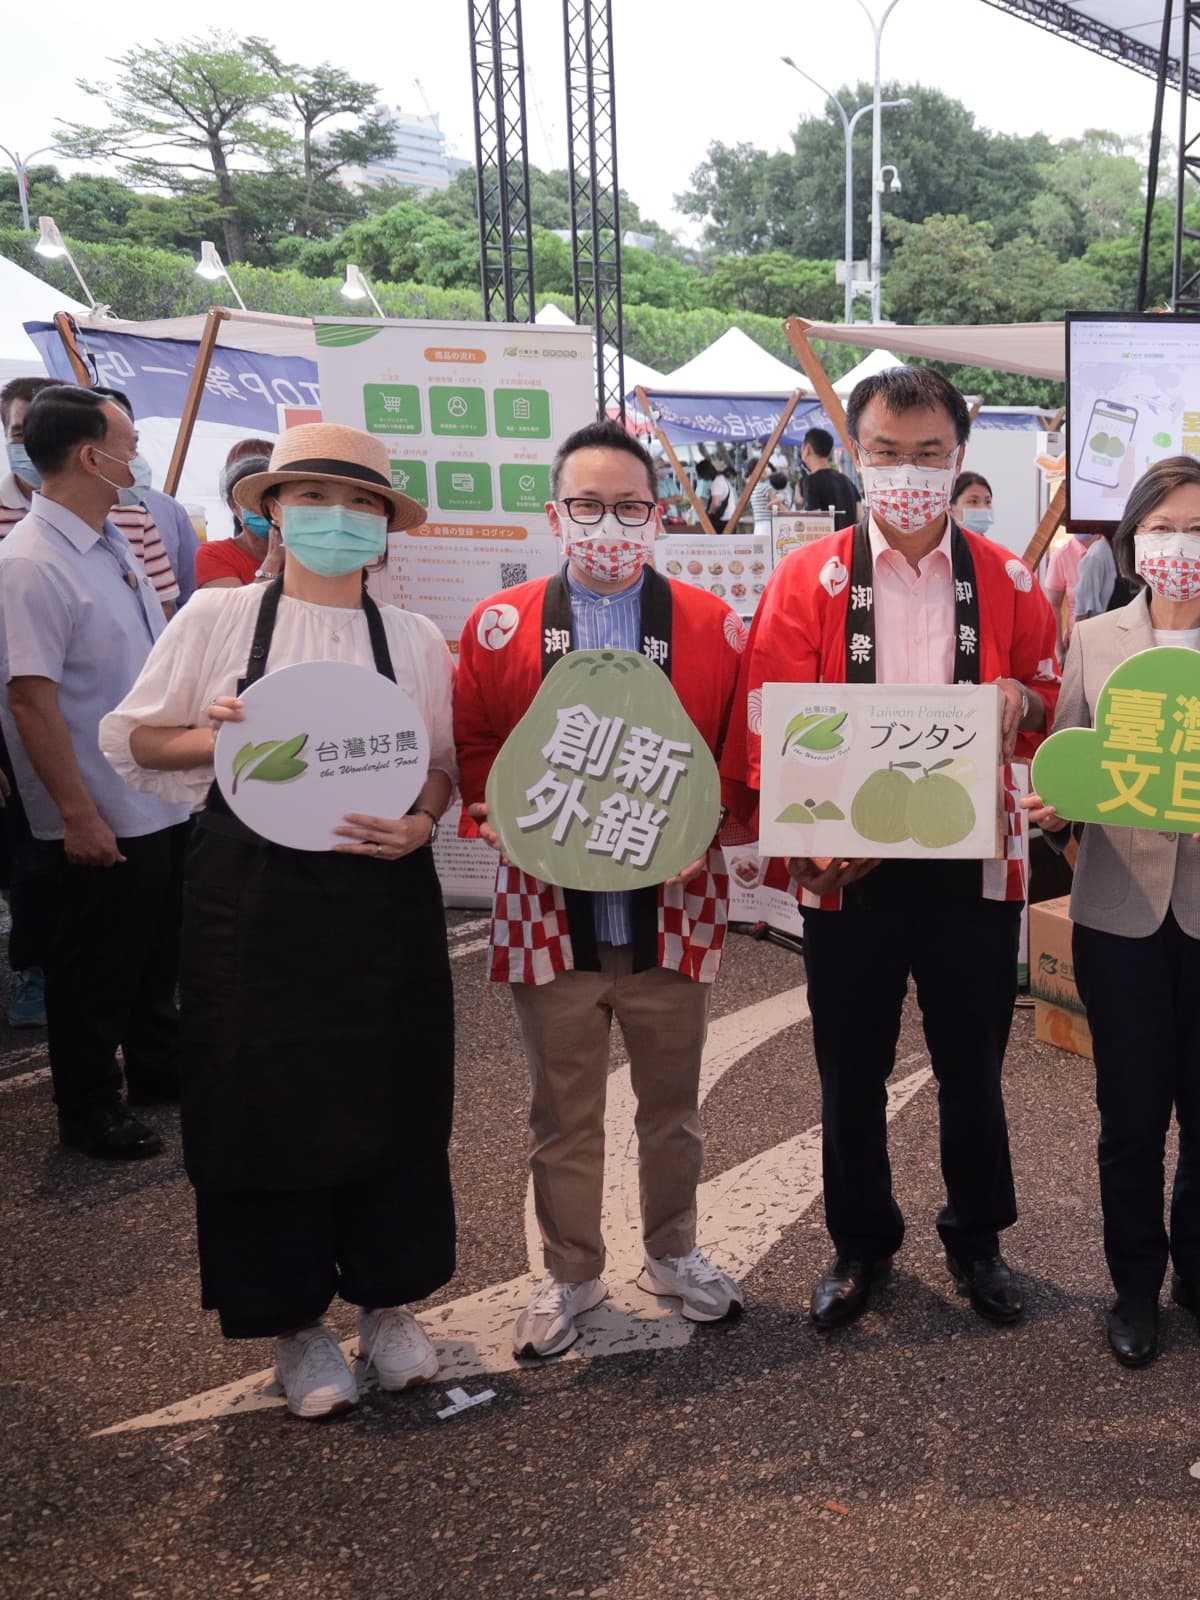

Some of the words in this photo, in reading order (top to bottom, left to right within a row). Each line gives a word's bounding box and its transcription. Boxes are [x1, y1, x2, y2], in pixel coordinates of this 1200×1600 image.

[544, 627, 571, 655] 御
[643, 635, 669, 666] 御
[869, 705, 914, 718] Taiwan
[919, 704, 963, 718] Pomelo
[315, 730, 419, 762] 台灣好農
[870, 721, 977, 750] ブンタン
[320, 768, 335, 778] the
[339, 760, 390, 776] Wonderful
[394, 757, 418, 768] Food
[542, 704, 693, 801] 創新
[516, 771, 668, 868] 外銷
